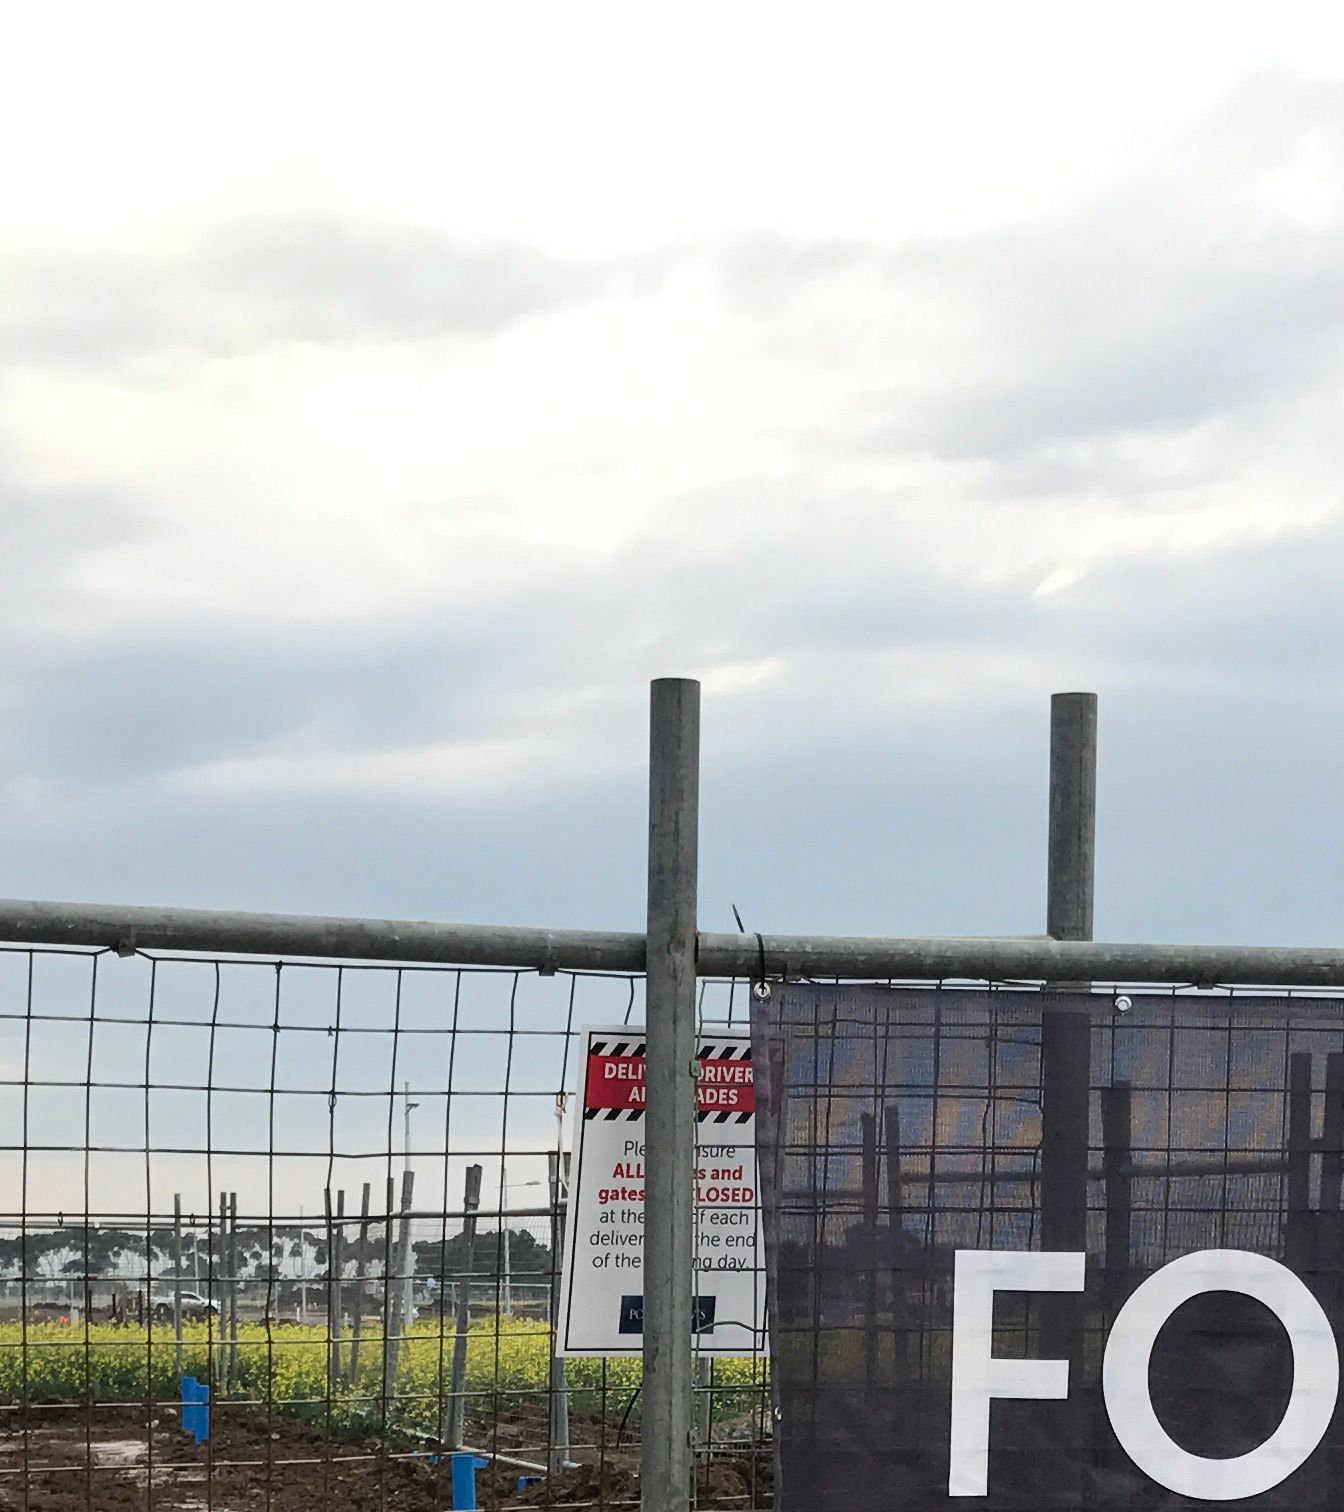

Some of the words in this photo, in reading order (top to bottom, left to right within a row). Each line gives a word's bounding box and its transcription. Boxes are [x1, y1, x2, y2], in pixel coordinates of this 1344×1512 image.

[605, 1063, 646, 1079] DELI
[697, 1066, 754, 1083] RIVER
[694, 1088, 738, 1105] ADES
[624, 1141, 645, 1157] Ple
[697, 1146, 736, 1158] sure
[613, 1163, 645, 1178] ALL
[710, 1165, 743, 1180] and
[598, 1187, 645, 1205] gates
[697, 1187, 754, 1202] LOSED
[600, 1209, 615, 1224] at
[621, 1209, 645, 1223] the
[710, 1211, 749, 1225] each
[589, 1231, 645, 1246] deliver
[725, 1232, 757, 1247] end
[592, 1253, 611, 1268] of
[615, 1253, 642, 1268] the
